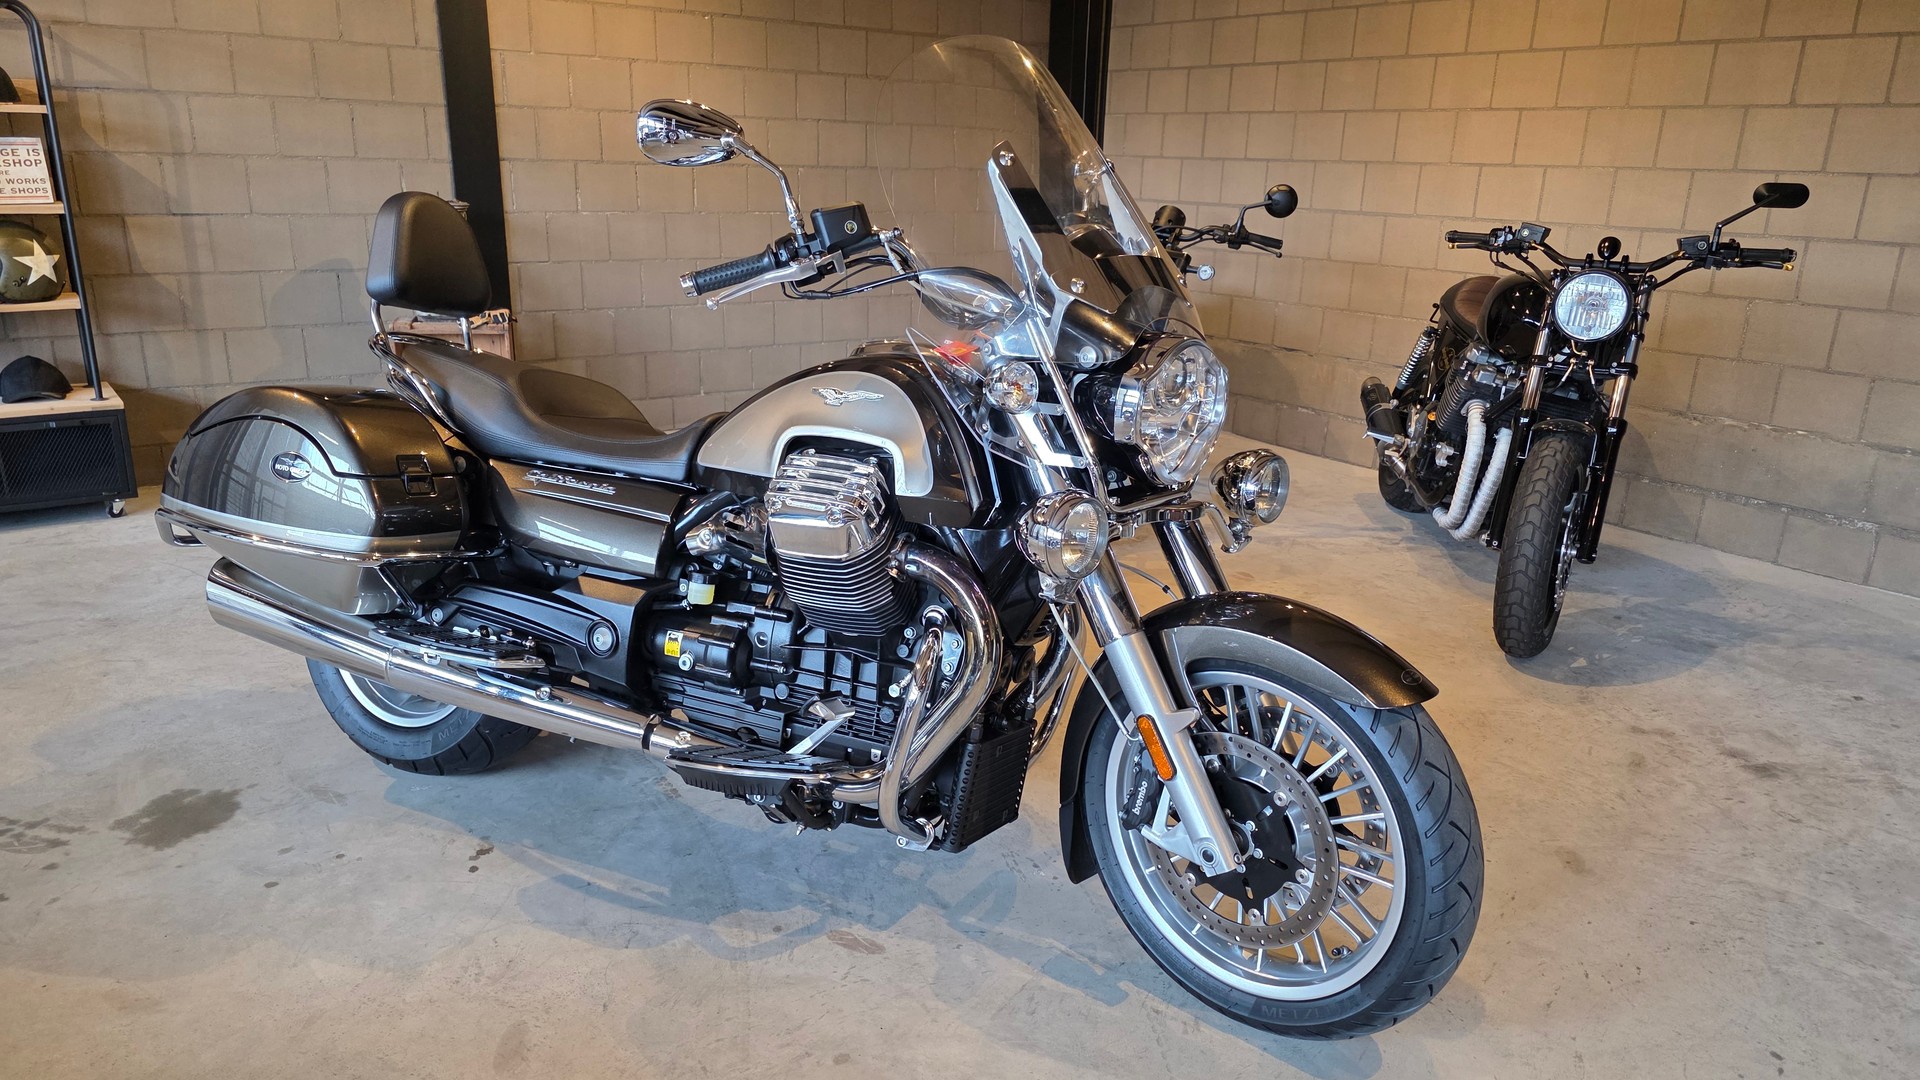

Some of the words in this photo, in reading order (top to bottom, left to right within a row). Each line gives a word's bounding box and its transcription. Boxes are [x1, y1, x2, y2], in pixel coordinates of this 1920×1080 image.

[0, 148, 20, 157] GE
[26, 148, 40, 157] IS
[0, 159, 42, 167] SHOP
[274, 463, 290, 472] MOTO
[1131, 780, 1149, 816] brembo
